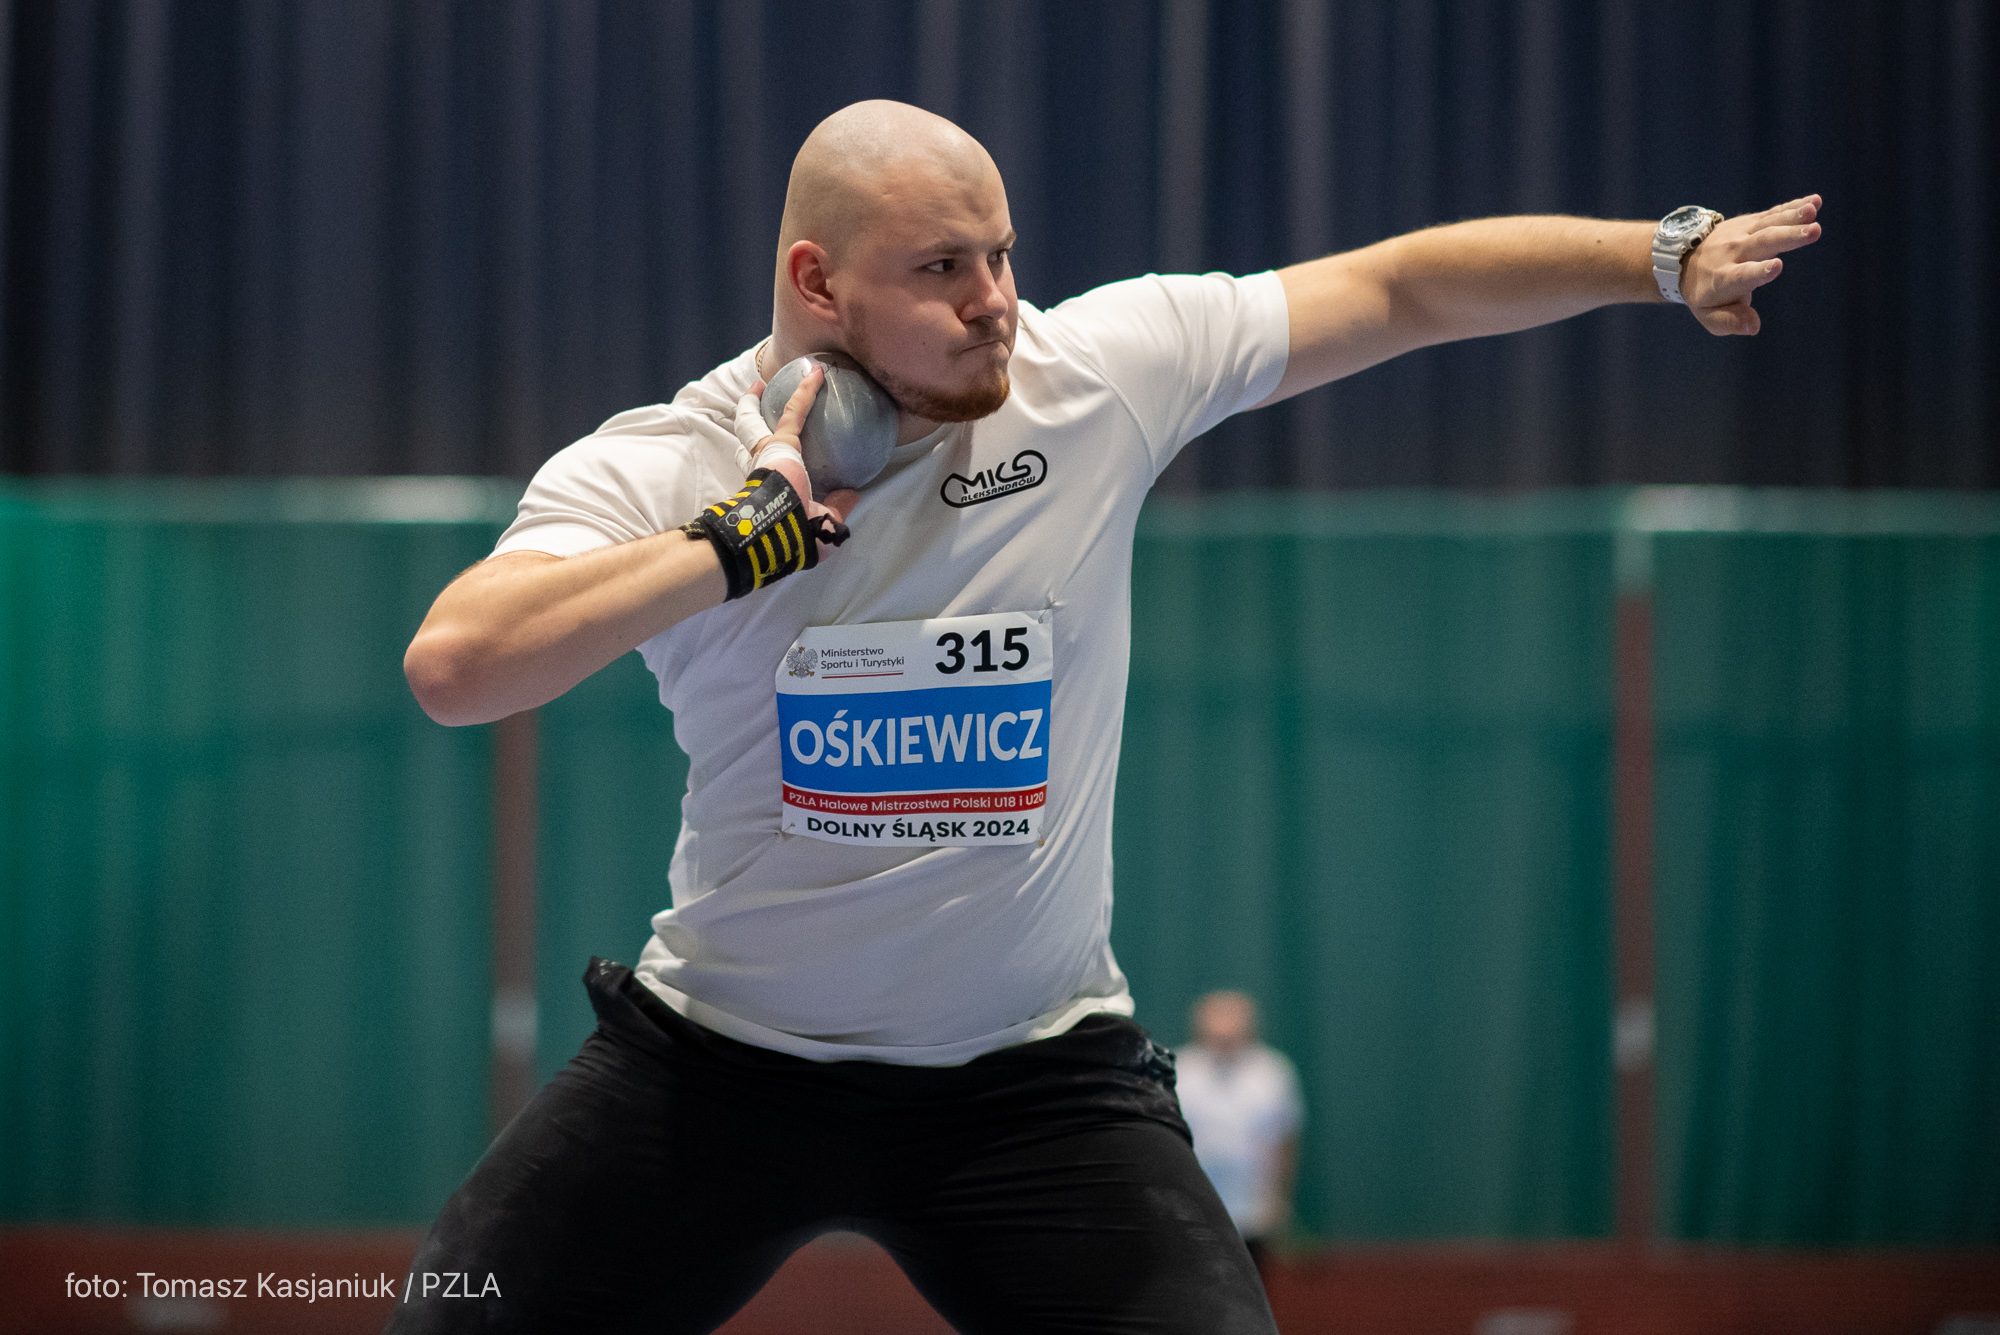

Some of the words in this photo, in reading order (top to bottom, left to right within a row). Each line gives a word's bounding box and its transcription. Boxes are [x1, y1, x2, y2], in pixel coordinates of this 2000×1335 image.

[960, 475, 1036, 503] ALEKSANDRÓW
[738, 531, 757, 547] SPORT
[757, 501, 792, 529] NUTRITION
[820, 659, 853, 671] Sportu
[855, 659, 859, 668] i
[861, 656, 905, 669] Turystyki
[821, 646, 884, 658] Ministerstwo
[935, 626, 1030, 675] 315
[789, 708, 1044, 768] OŚKIEWICZ
[789, 792, 817, 808] PZLA
[819, 798, 868, 812] Halowe
[871, 797, 950, 813] Mistrzostwa
[953, 795, 991, 810] Polski
[994, 796, 1016, 808] U18
[1019, 795, 1023, 806] i
[1025, 791, 1045, 806] U20
[806, 816, 886, 839] DOLNY
[891, 817, 967, 842] ŚLĄSK
[972, 818, 1031, 837] 2024
